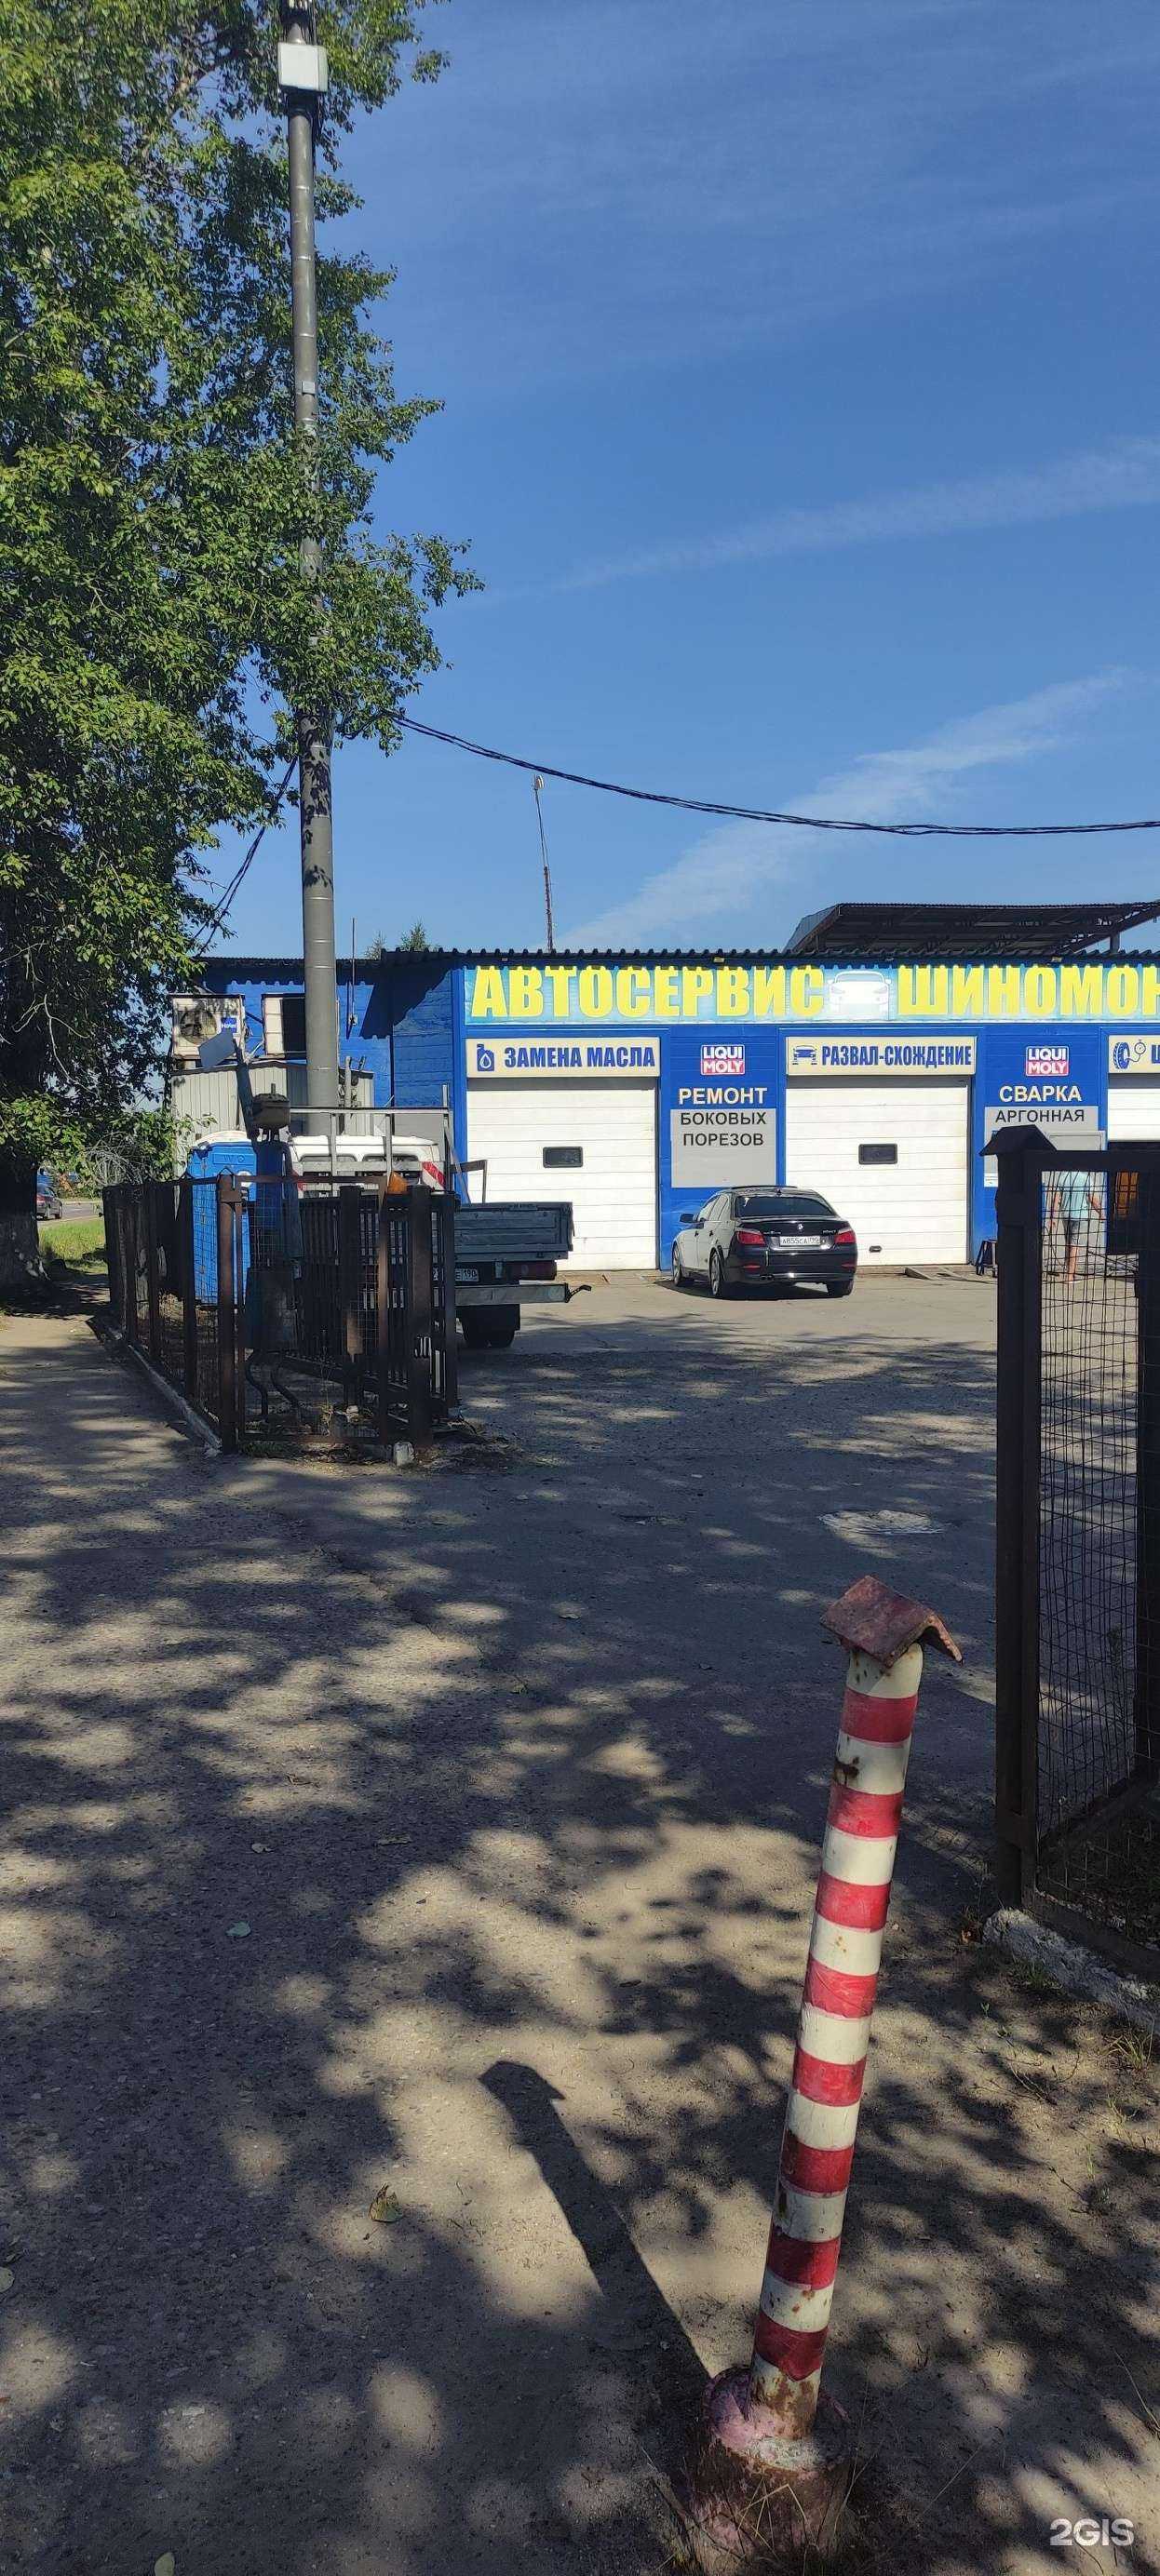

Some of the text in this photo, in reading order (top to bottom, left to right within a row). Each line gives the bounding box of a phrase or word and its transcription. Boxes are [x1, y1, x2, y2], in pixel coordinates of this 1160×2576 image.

[471, 965, 826, 1018] АВТОСЕРВИС
[504, 1046, 656, 1068] ЗАМЕНА МАСЛА
[703, 1046, 743, 1060] LIQUI
[821, 1045, 972, 1068] РАЗВАЛ-СХОЖДЕНИЕ
[1028, 1048, 1067, 1061] LIQUI
[703, 1060, 745, 1073] MOLY
[1028, 1061, 1068, 1074] MOLY
[679, 1087, 767, 1105] РЕМОНТ
[999, 1085, 1083, 1103] СВАРКА
[680, 1111, 767, 1125] БОКОВЫХ
[995, 1109, 1085, 1123] АРГОННАЯ
[682, 1133, 764, 1147] ПОРЕЗОВ
